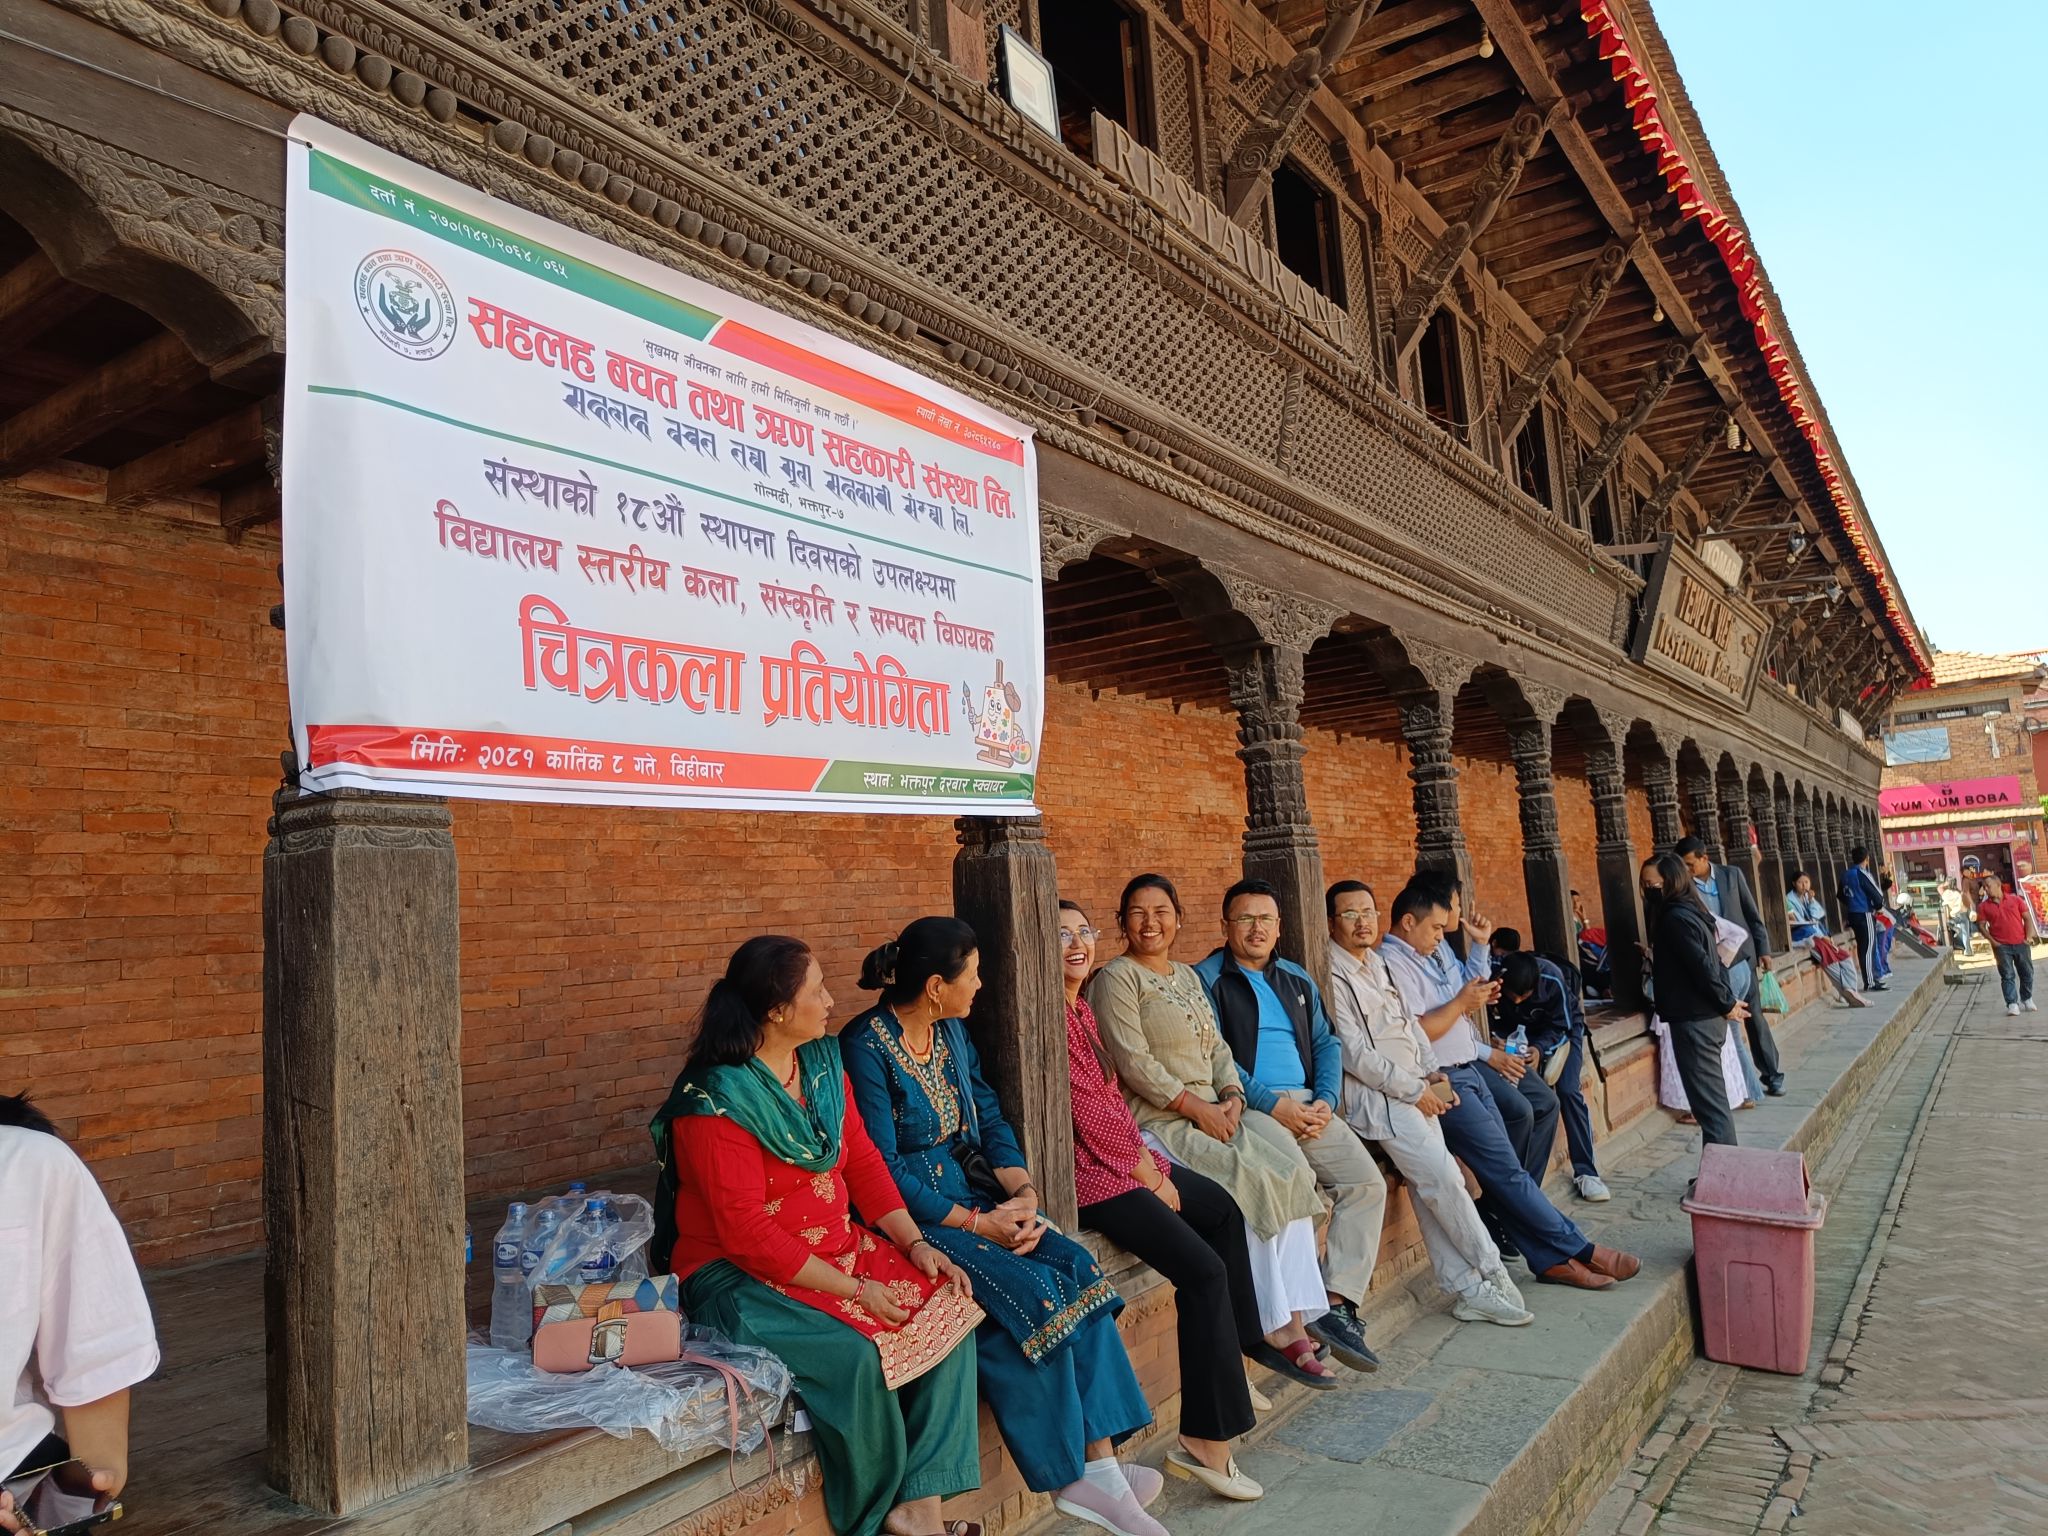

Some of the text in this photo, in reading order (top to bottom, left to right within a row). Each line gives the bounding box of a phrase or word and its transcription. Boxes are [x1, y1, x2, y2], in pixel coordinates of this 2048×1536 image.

[369, 183, 396, 207] दर्ता
[1113, 119, 1348, 348] RESTAURANT
[467, 296, 1016, 520] सहलह बचत तथा ऋण सहकारी संस्था लि.
[726, 370, 748, 388] लागि
[750, 380, 770, 397] हामी
[774, 386, 810, 413] मिलिजुली
[814, 404, 830, 420] काम
[433, 498, 995, 654] विद्यालय स्तरीय कला, संस्कृति र सम्पदा विषयक
[483, 457, 598, 518] संस्थाको
[699, 511, 776, 560] स्थापना
[786, 529, 862, 582] दिवसको
[872, 558, 956, 602] उपलक्ष्यमा
[517, 592, 952, 737] चित्रकला प्रतियोगिता
[478, 745, 535, 770] २०८१
[546, 744, 604, 774] कार्तिक
[612, 756, 623, 774] ८
[670, 754, 726, 784] बिहीबार
[900, 774, 937, 796] भक्तपुर
[940, 777, 970, 794] दरबार
[1891, 792, 2009, 812] YUM YUM BOBA
